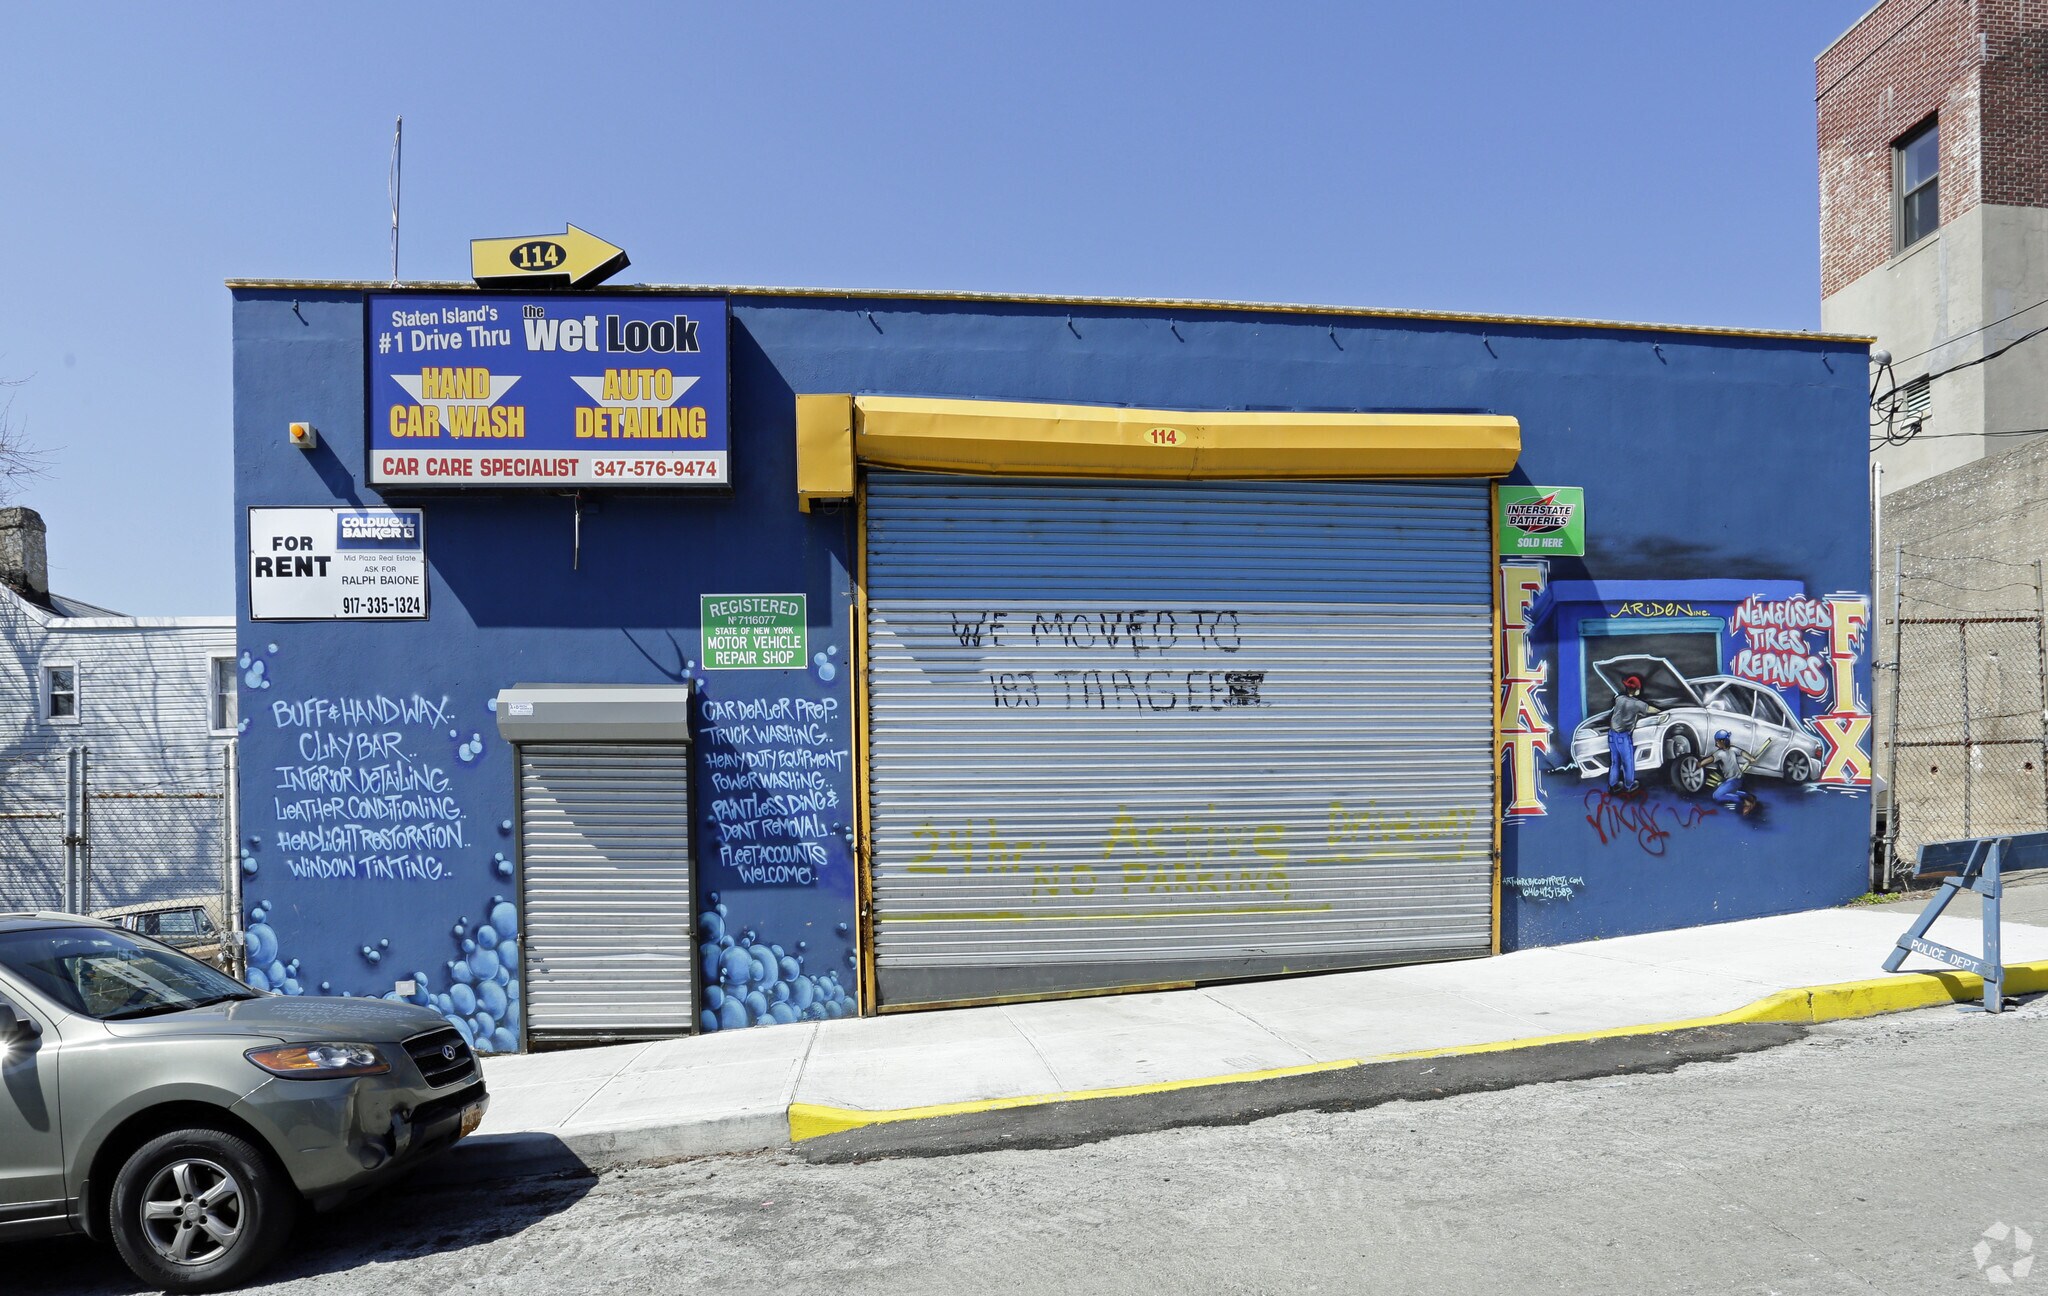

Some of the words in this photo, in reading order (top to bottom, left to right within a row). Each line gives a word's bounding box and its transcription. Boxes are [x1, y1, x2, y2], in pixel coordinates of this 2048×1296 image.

[518, 244, 559, 268] 114
[391, 309, 439, 328] Staten
[441, 305, 498, 325] Island's
[523, 304, 545, 319] the
[411, 328, 463, 352] Drive
[466, 324, 511, 347] Thru
[606, 315, 700, 353] Look
[421, 367, 491, 400] HAND
[602, 368, 674, 400] AUTO
[389, 404, 441, 438] CAR
[448, 405, 526, 438] WASH
[575, 406, 707, 438] DETAILING
[1151, 429, 1177, 445] 114
[383, 457, 419, 477] CAR
[425, 457, 473, 477] CARE
[480, 457, 579, 477] SPECIALIST
[594, 460, 717, 478] 347-576-9474
[1507, 505, 1572, 515] INTERSTATE
[1509, 516, 1567, 525] BATTERIES
[272, 536, 314, 551] FOR
[1517, 538, 1540, 548] SOLD
[1542, 538, 1564, 548] HERE
[255, 555, 332, 578] RENT
[344, 554, 356, 562] Mid
[359, 554, 376, 562] Plaza
[379, 554, 394, 562] Real
[396, 554, 416, 562] Estate
[364, 565, 379, 573] ASK
[382, 565, 397, 573] FOR
[342, 576, 376, 585] RALPH
[380, 576, 420, 585] BAIONE
[343, 597, 420, 614] 917-335-1324
[709, 598, 799, 618] REGISTERED
[715, 627, 738, 635] STATE
[740, 627, 750, 635] OF
[753, 627, 770, 635] NEW
[773, 626, 794, 635] YORK
[951, 609, 1007, 647] WE
[1032, 609, 1177, 652] MOVED
[1191, 609, 1242, 652] TO
[1746, 626, 1807, 655] TIRES
[707, 636, 747, 650] MOTOR
[753, 635, 802, 649] VEHICLE
[715, 651, 757, 665] REPAIR
[762, 650, 794, 664] SHOP
[1737, 649, 1827, 692] REPAIRS
[1500, 563, 1549, 816] FLAT
[1815, 596, 1871, 787] FIX
[700, 724, 754, 746] TRUCK
[1031, 863, 1098, 903] NO
[1121, 861, 1290, 902] PARKING
[1910, 938, 1946, 962] POLICE
[1949, 953, 1980, 974] DEPT.
